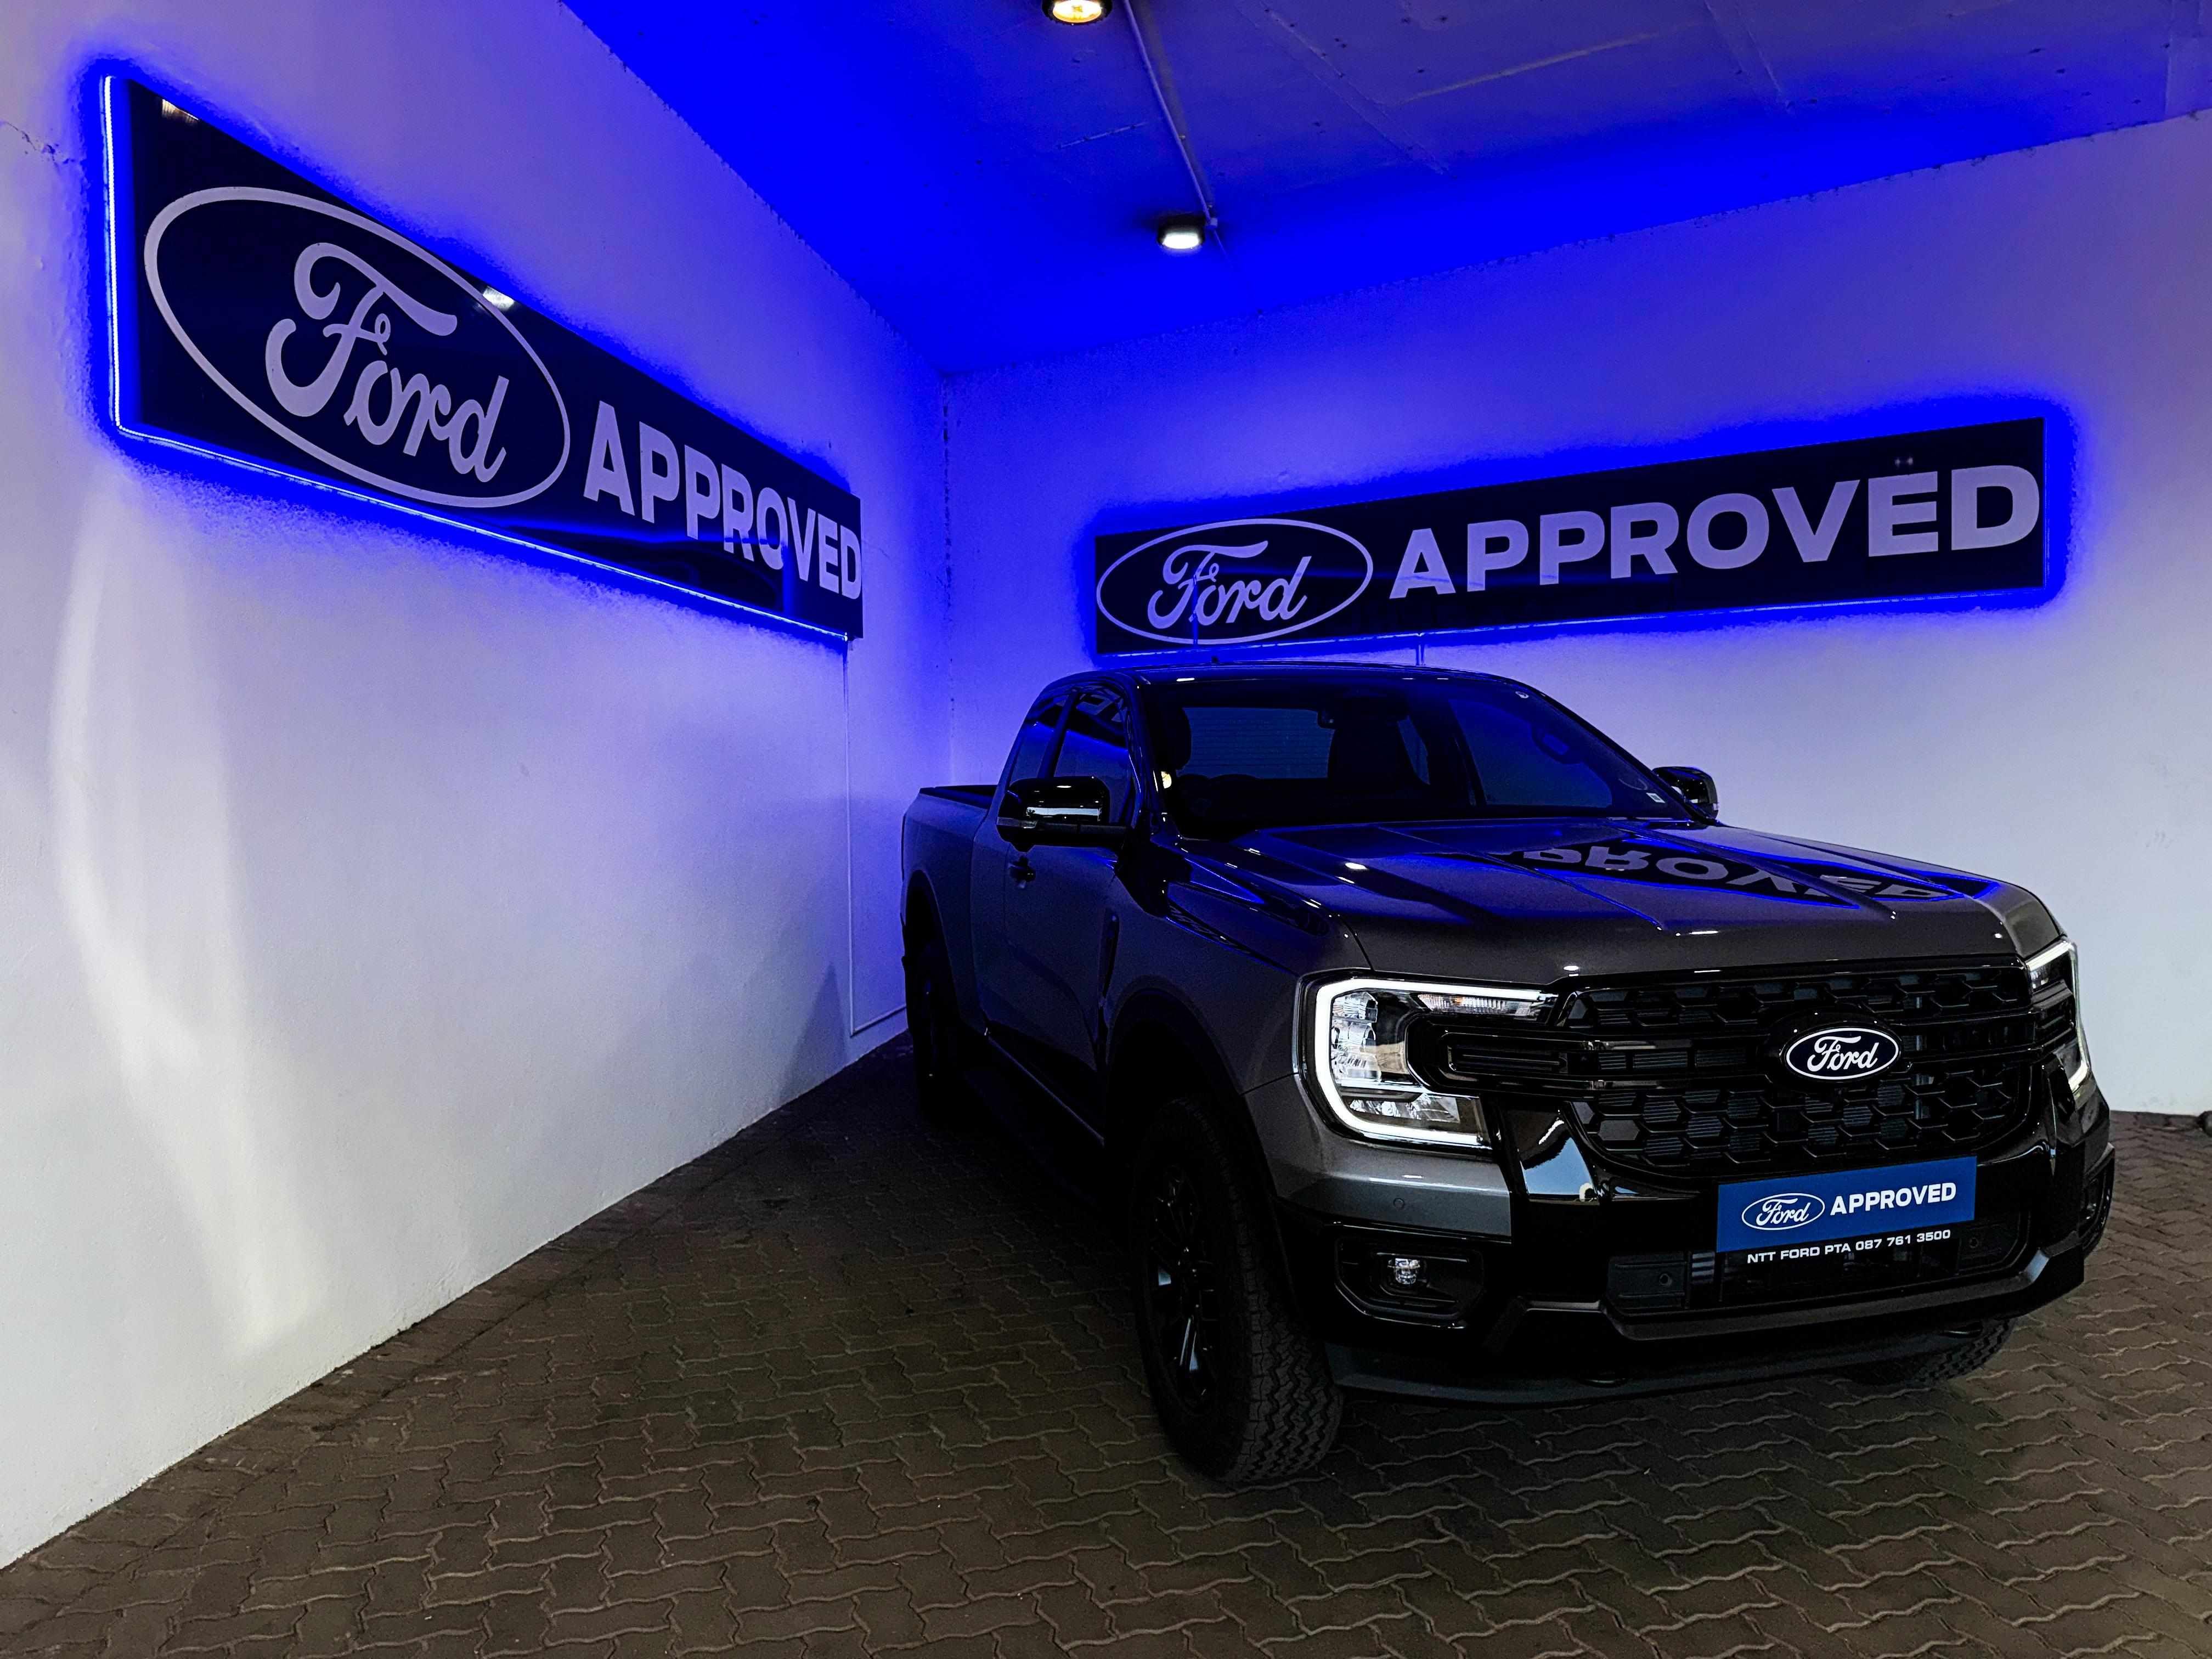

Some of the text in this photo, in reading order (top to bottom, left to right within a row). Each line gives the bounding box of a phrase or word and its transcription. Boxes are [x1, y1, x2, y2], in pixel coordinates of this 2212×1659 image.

[265, 242, 862, 600] Ford APPROVED
[1147, 465, 2040, 630] Ford APPROVED
[1807, 1036, 1880, 1072] Ford
[1756, 1182, 1956, 1226] Ford APPROVED
[1747, 1229, 1951, 1264] NTT FORD PTA 087 761 3500
